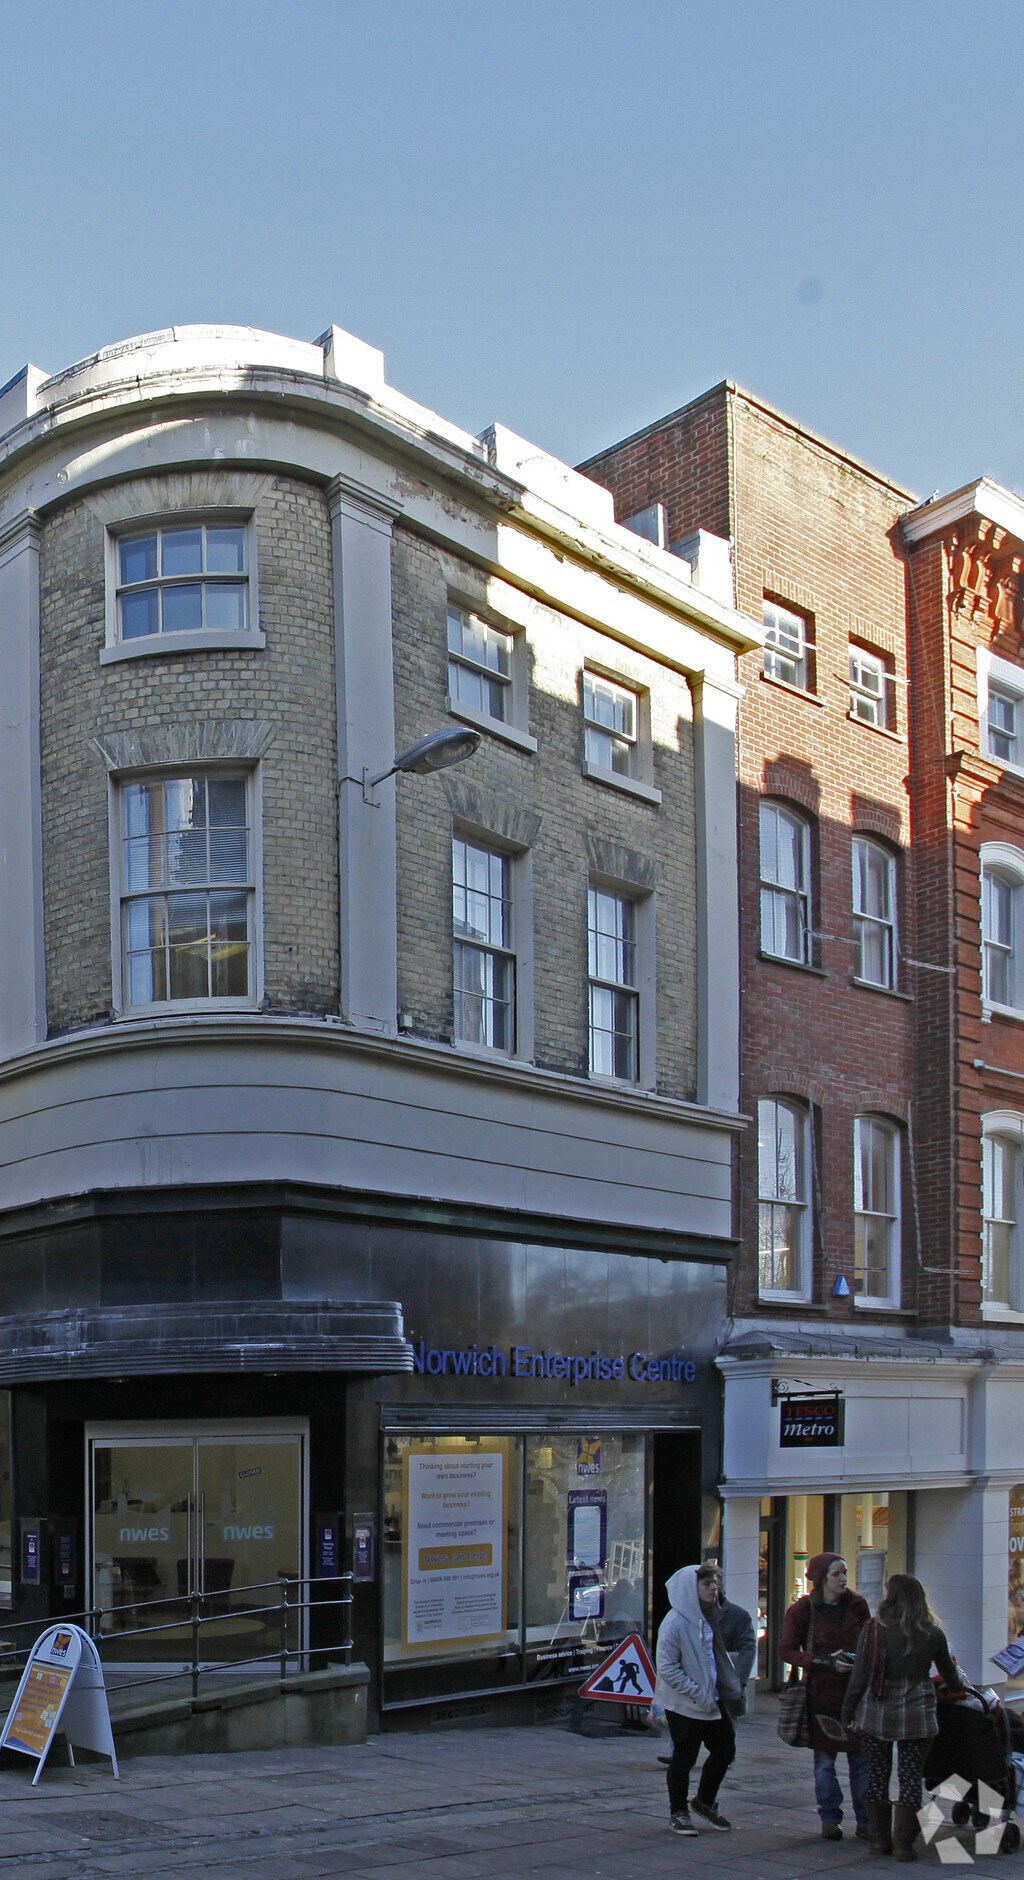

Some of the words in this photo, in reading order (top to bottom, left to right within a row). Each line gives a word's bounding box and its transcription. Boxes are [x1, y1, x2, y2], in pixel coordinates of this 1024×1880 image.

[407, 1341, 506, 1376] Norwich
[514, 1345, 625, 1385] Enterprise
[630, 1350, 697, 1382] Centre
[786, 1406, 836, 1417] TESCO
[419, 1463, 443, 1471] Thinking
[444, 1462, 459, 1470] about
[460, 1462, 480, 1470] starting
[481, 1462, 493, 1470] your
[577, 1463, 600, 1474] nwes
[239, 1468, 262, 1478] CLOSED
[421, 1492, 436, 1500] Want
[442, 1493, 456, 1501] grow
[457, 1492, 469, 1500] your
[470, 1490, 491, 1499] existing
[442, 1501, 470, 1509] business?
[432, 1520, 463, 1529] commercial
[463, 1520, 487, 1528] premises
[119, 1527, 169, 1542] nwes
[224, 1525, 274, 1540] nwes
[435, 1530, 457, 1538] meeting
[536, 1653, 558, 1661] Business
